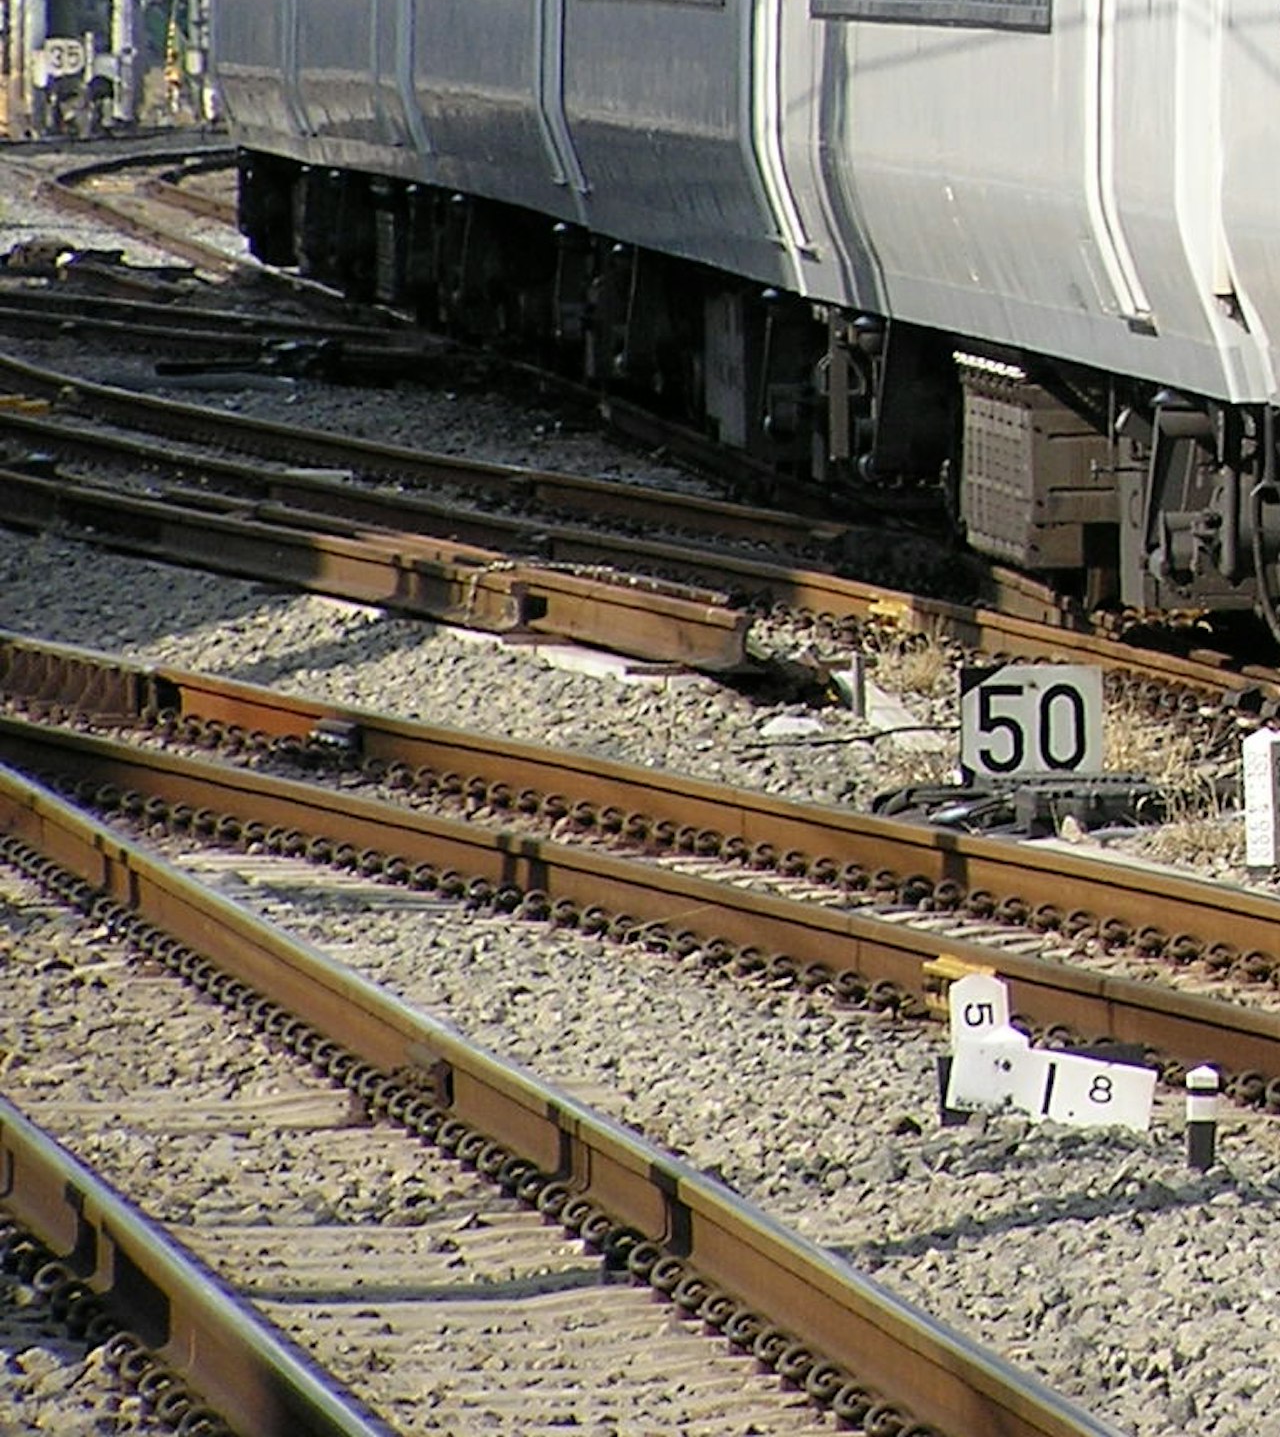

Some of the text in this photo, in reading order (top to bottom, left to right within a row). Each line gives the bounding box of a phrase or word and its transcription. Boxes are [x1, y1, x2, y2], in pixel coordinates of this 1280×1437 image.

[50, 45, 80, 69] 35
[977, 683, 1087, 773] 50
[964, 1002, 994, 1027] 5
[1088, 1075, 1113, 1104] 8
